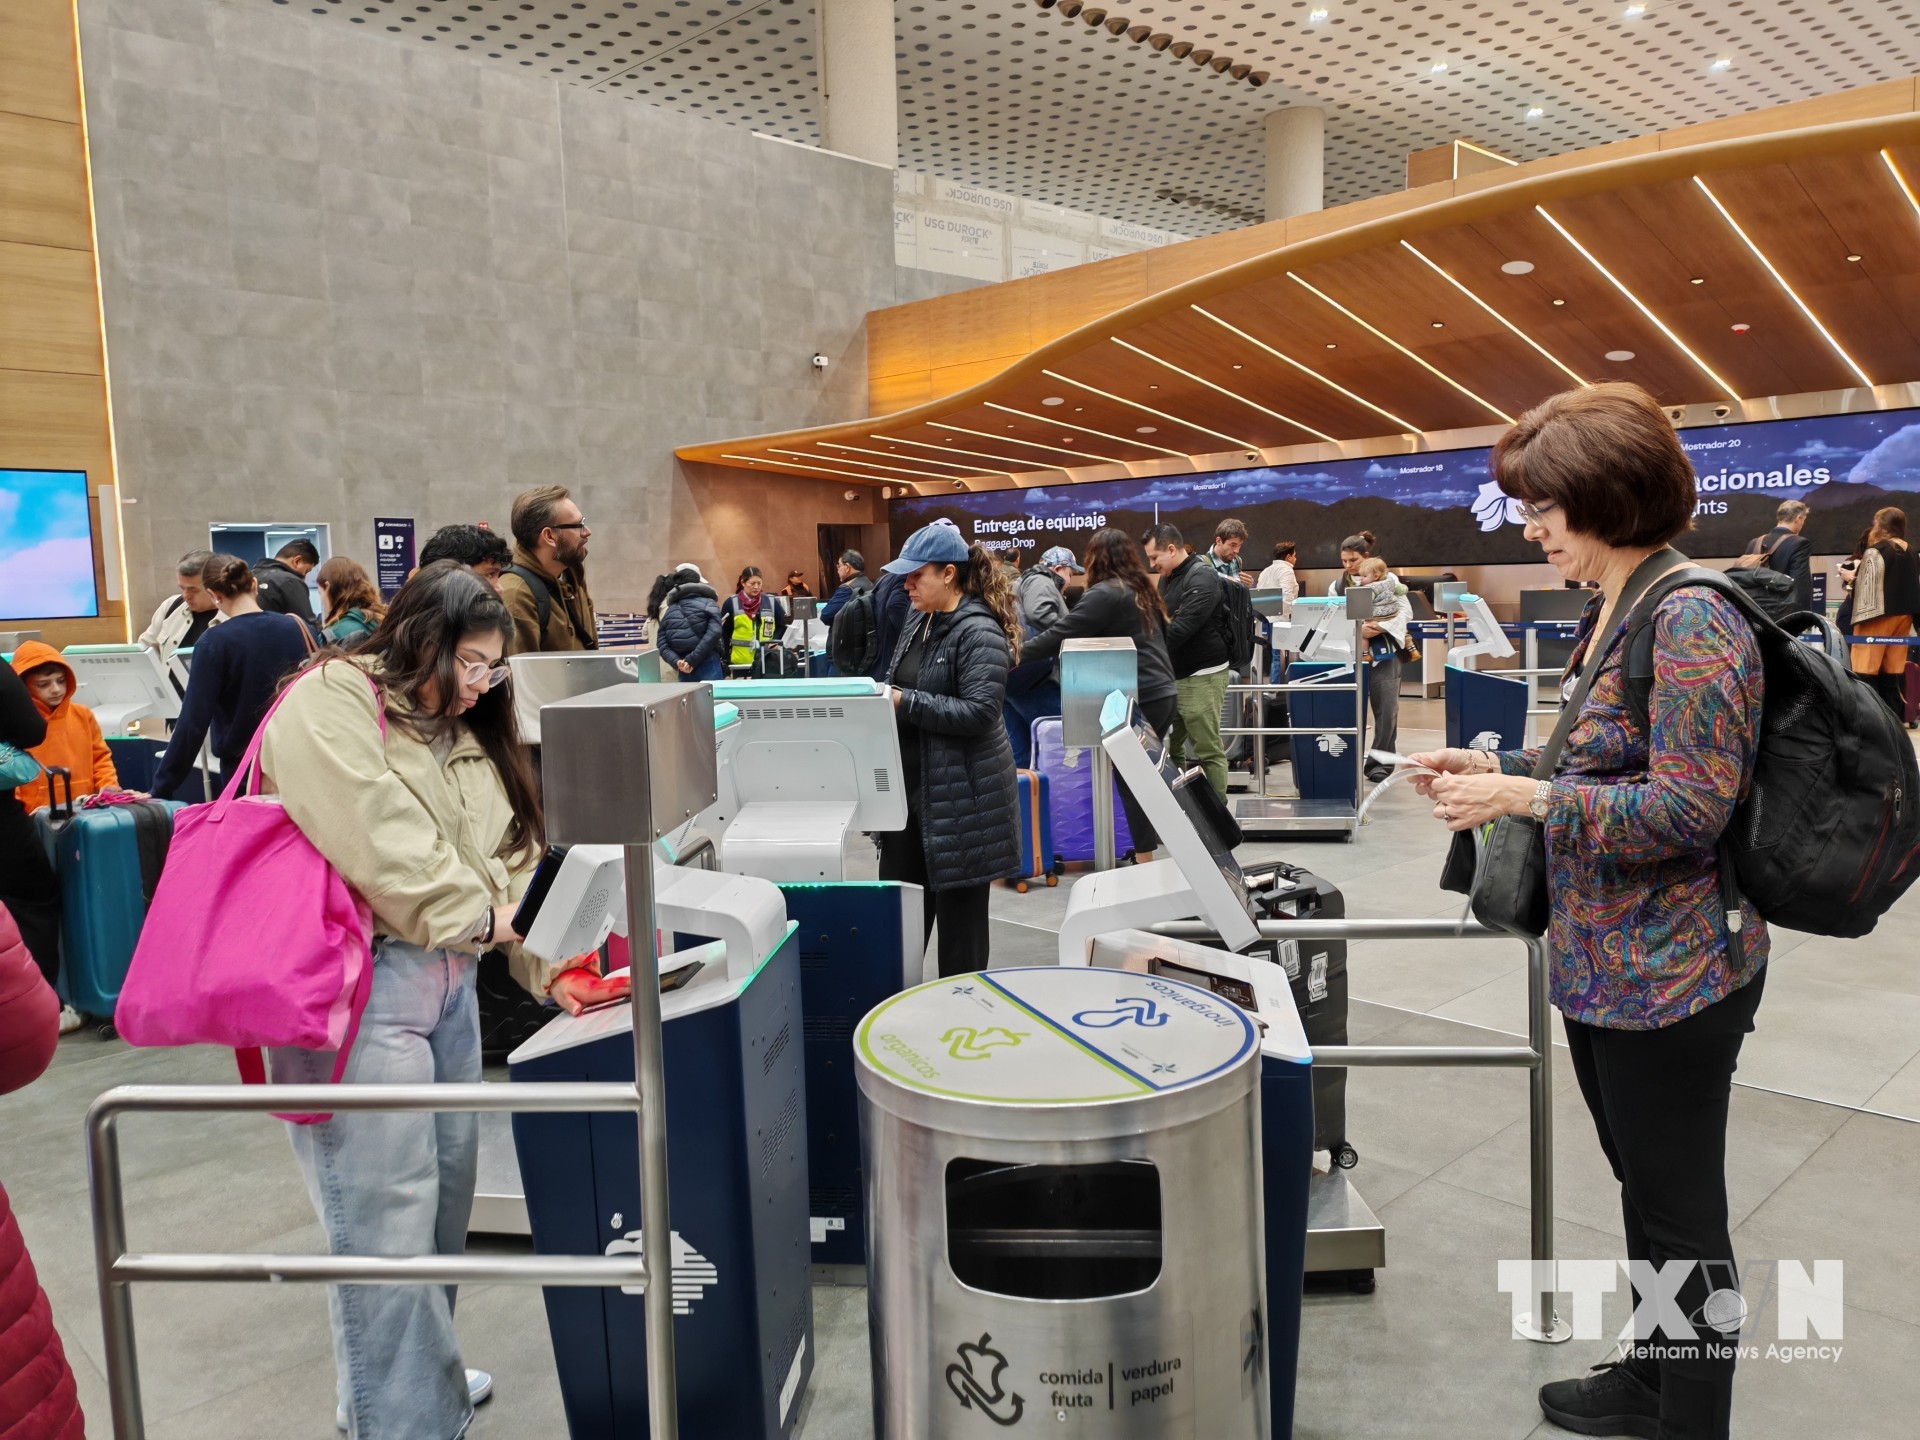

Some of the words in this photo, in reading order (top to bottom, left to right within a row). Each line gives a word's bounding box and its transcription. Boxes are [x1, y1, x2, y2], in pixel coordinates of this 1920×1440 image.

[993, 198, 1012, 211] USG
[924, 217, 945, 230] USG
[1728, 439, 1741, 448] 20
[1400, 466, 1436, 474] Mostrador
[1193, 483, 1220, 491] Mostrador
[974, 519, 1025, 534] Entrega
[1027, 515, 1044, 530] de
[1046, 511, 1107, 531] equipaje
[1012, 537, 1035, 549] Drop
[1121, 1358, 1181, 1381] verdura
[1039, 1369, 1103, 1385] comida
[1131, 1377, 1174, 1406] papel
[1051, 1391, 1093, 1407] fruta
